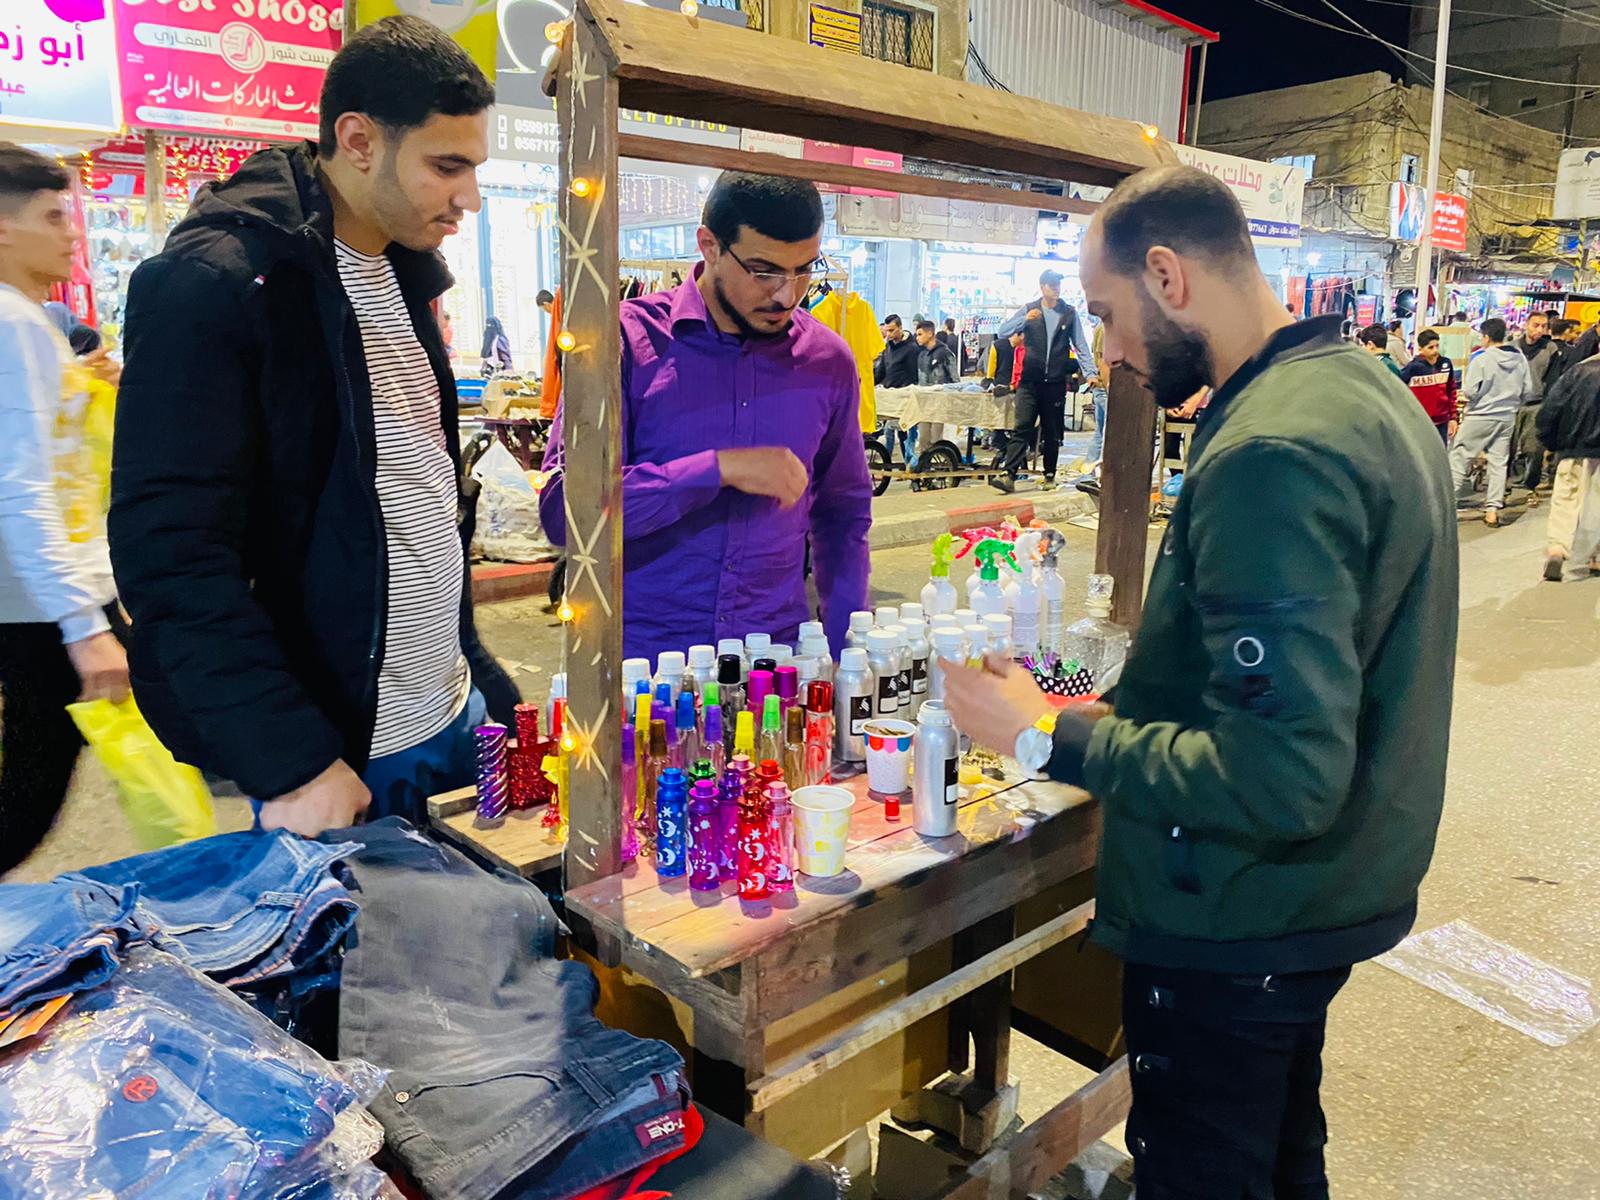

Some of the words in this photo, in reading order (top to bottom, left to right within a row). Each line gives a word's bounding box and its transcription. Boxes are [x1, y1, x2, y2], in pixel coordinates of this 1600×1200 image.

[39, 22, 84, 67] أبو
[144, 71, 200, 104] العالمية
[202, 75, 276, 108] الماركات
[1221, 163, 1263, 193] محلات
